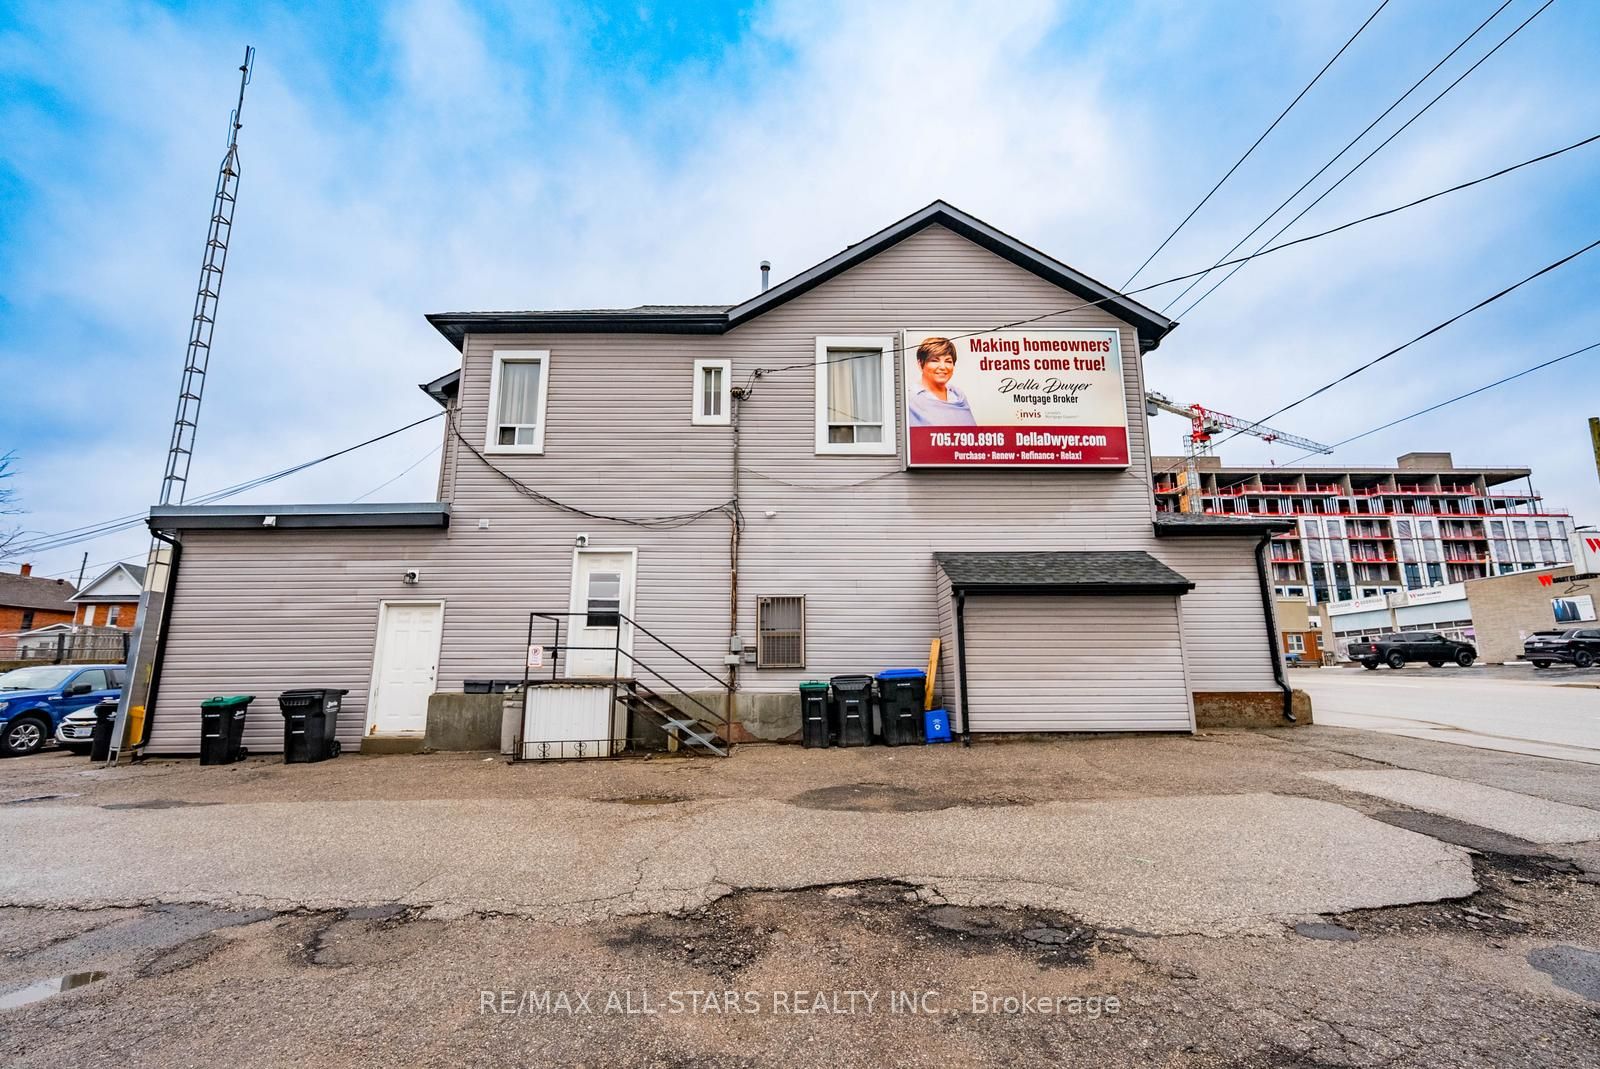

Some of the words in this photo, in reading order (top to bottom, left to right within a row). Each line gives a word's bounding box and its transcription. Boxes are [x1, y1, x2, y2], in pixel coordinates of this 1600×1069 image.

[970, 338, 1020, 355] Making
[979, 357, 1030, 371] dreams
[1034, 357, 1070, 371] come
[1074, 357, 1106, 371] true!
[998, 377, 1040, 394] Della
[1044, 377, 1093, 395] Dwyer
[1013, 394, 1051, 404] Mortgage
[1053, 394, 1079, 404] Broker
[1019, 409, 1042, 419] invis
[930, 432, 1005, 447] 705.790.8916
[1015, 431, 1107, 449] DellaDwyer.com
[954, 451, 986, 461] Purchase
[991, 451, 1015, 461] Renew
[1020, 451, 1055, 461] Refinance
[1060, 451, 1082, 461] Relax!
